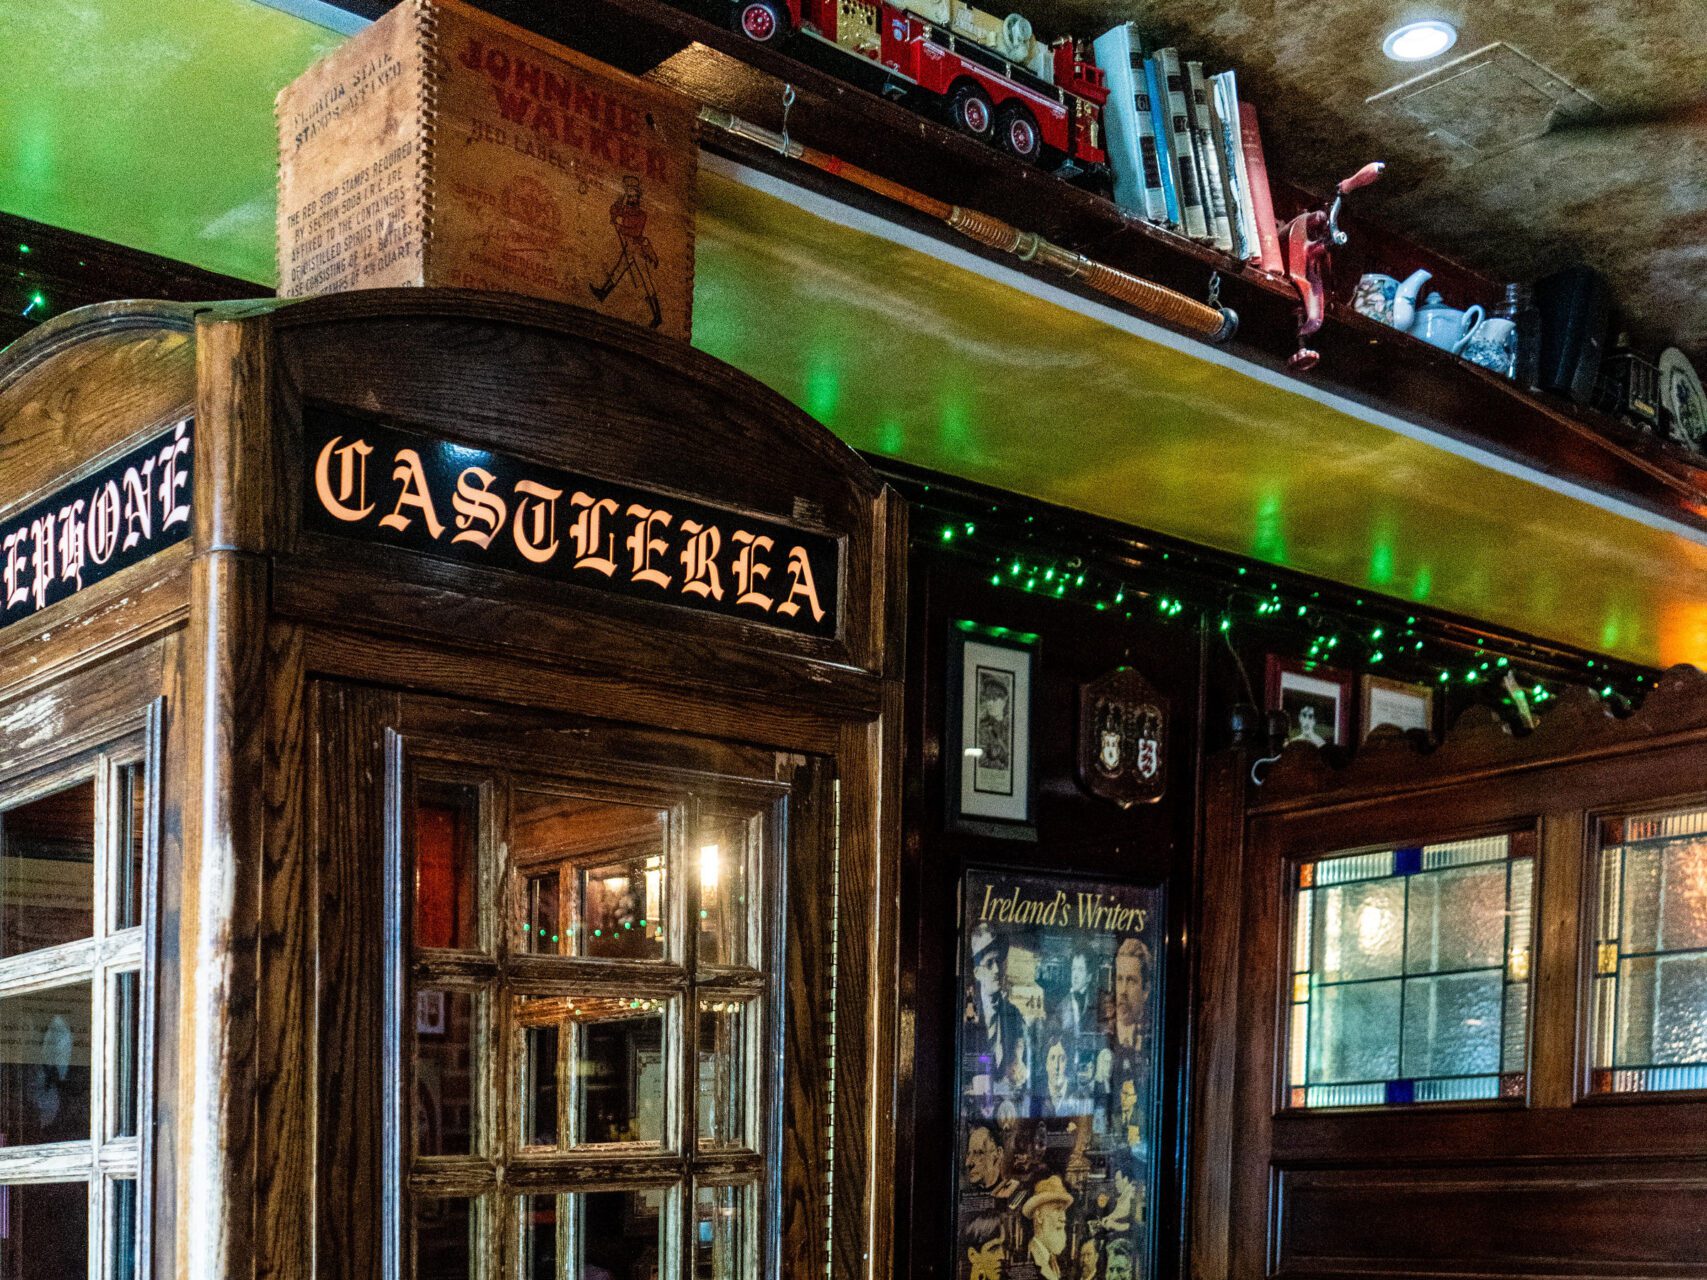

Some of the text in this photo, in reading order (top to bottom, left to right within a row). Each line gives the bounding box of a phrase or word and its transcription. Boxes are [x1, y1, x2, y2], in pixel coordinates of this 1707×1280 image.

[458, 38, 641, 137] JOHNNIE
[492, 84, 668, 183] WALKER
[514, 134, 568, 169] LABEL
[287, 212, 301, 229] THE
[302, 200, 317, 221] RED
[341, 167, 370, 196] STAMPS
[373, 141, 413, 174] REQUIRED
[308, 207, 340, 236] SECTION
[387, 166, 404, 187] ARE
[291, 235, 323, 262] AFFIXED
[326, 227, 336, 241] TO
[338, 217, 354, 236] THE
[344, 224, 372, 252] SPIRITS
[375, 218, 384, 234] IN
[378, 240, 412, 272] QUART
[305, 258, 346, 292] CONSISTING
[315, 435, 826, 623] CASTLEREA
[979, 884, 1148, 933] Ireland's Writers
